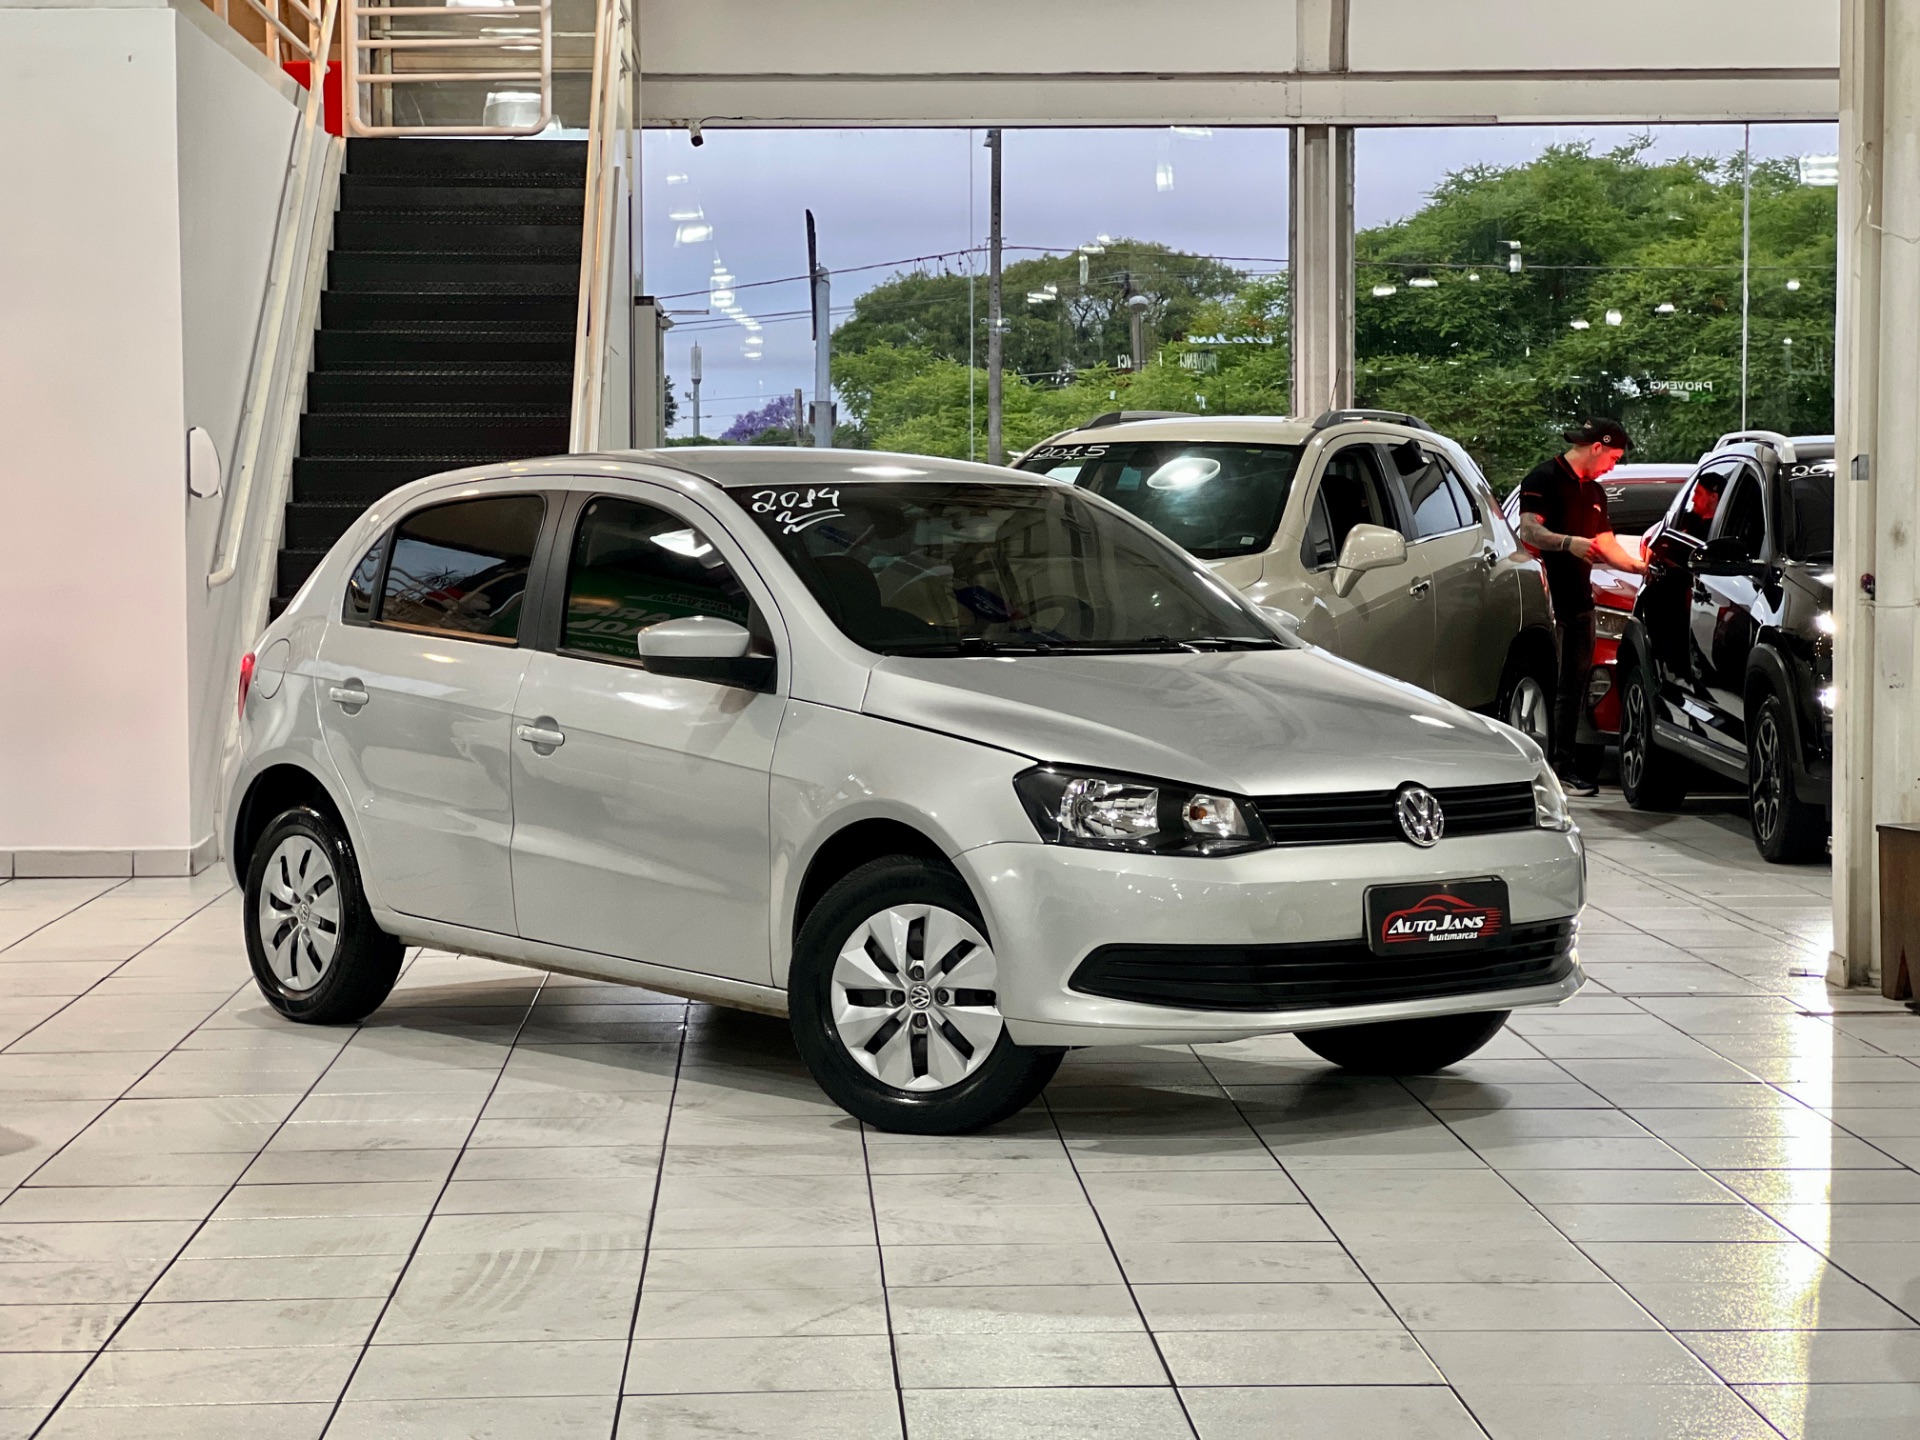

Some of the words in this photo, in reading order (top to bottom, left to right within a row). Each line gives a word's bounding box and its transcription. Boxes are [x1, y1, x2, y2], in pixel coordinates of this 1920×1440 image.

[1033, 444, 1110, 459] 2015
[1791, 465, 1834, 478] 20
[752, 487, 840, 513] 2014
[1388, 918, 1437, 934] AUTO
[1436, 915, 1486, 930] JANS
